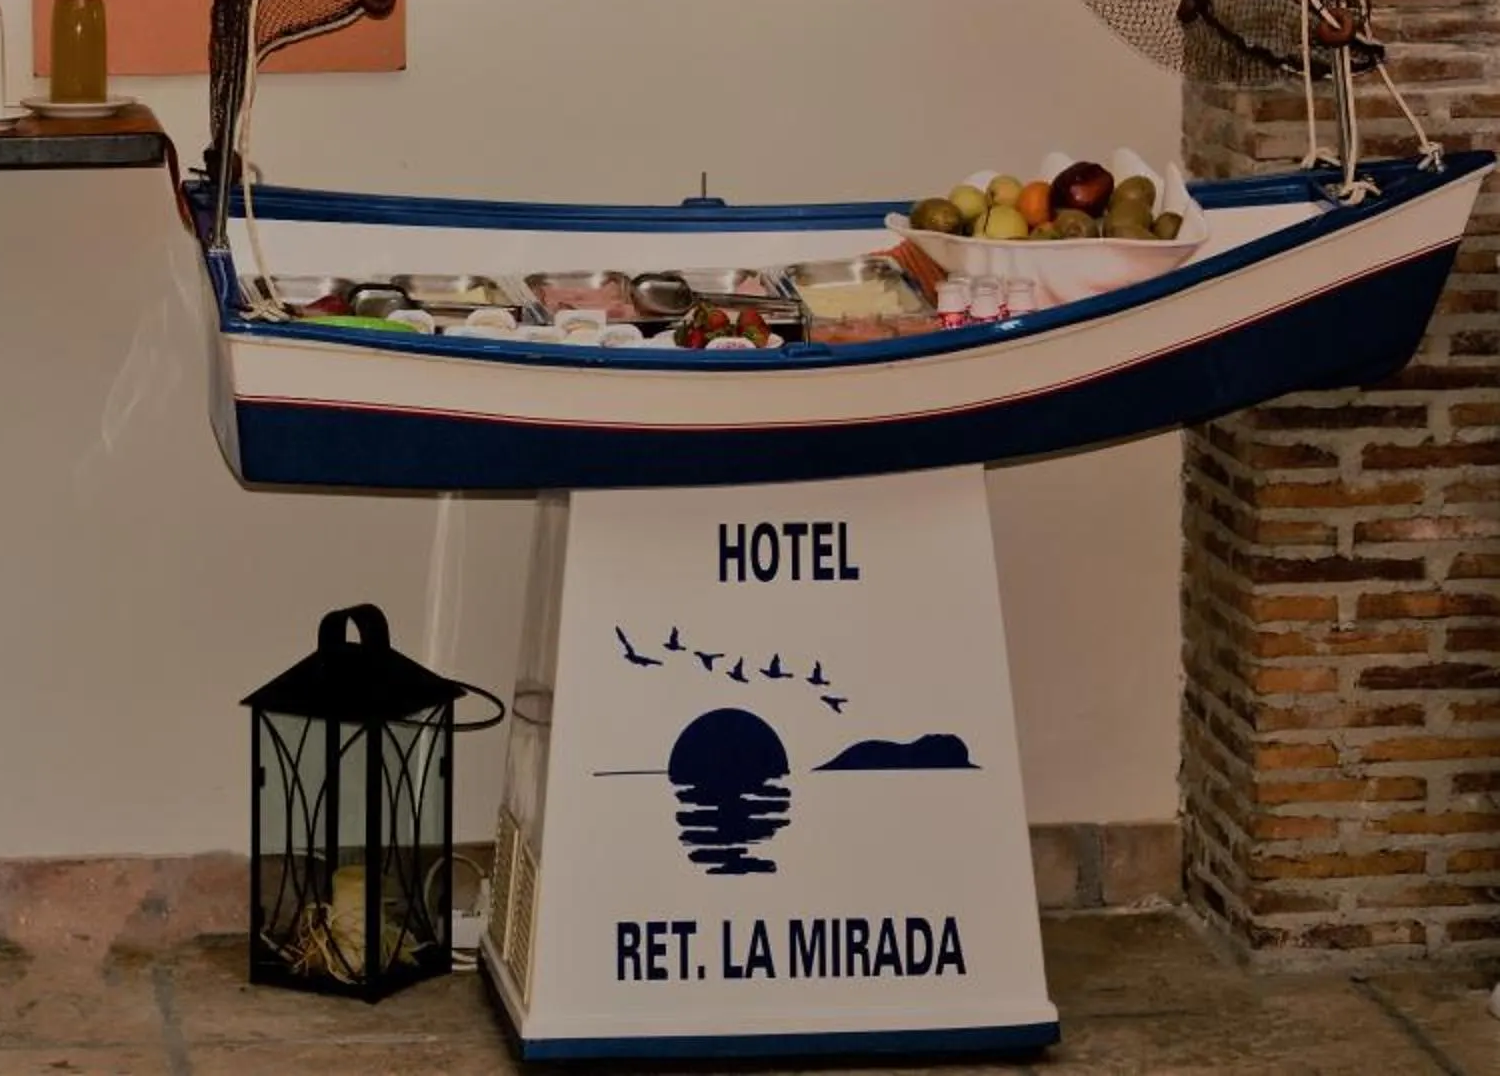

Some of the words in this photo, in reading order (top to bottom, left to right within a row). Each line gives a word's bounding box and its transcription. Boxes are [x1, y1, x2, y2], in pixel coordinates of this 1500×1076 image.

[719, 521, 860, 582] HOTEL
[617, 921, 706, 981] RET.
[722, 920, 776, 979] LA
[789, 917, 967, 978] MIRADA
